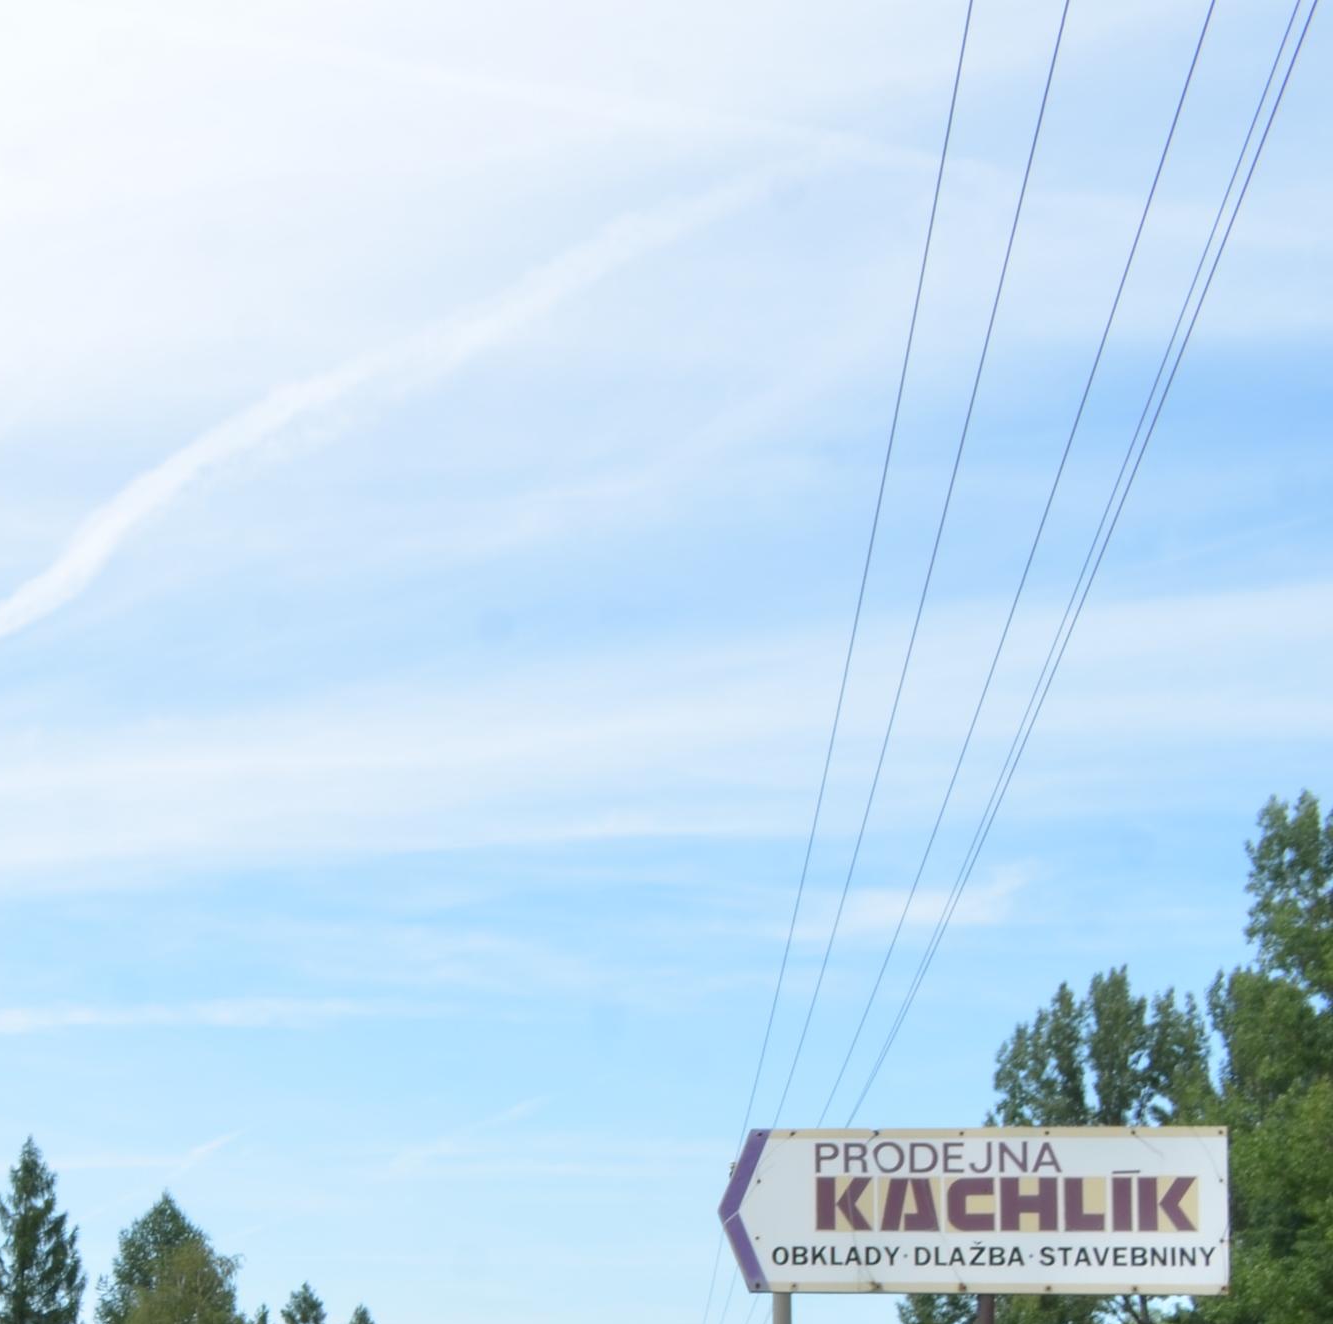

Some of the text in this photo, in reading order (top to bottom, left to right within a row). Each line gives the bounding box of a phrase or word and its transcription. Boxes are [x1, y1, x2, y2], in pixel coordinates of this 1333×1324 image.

[814, 1142, 1062, 1174] PRODEJNA
[816, 1170, 1198, 1233] KACHLÍK
[772, 1240, 1217, 1268] OBKLADY DLAŽBA STAVEBNINY
